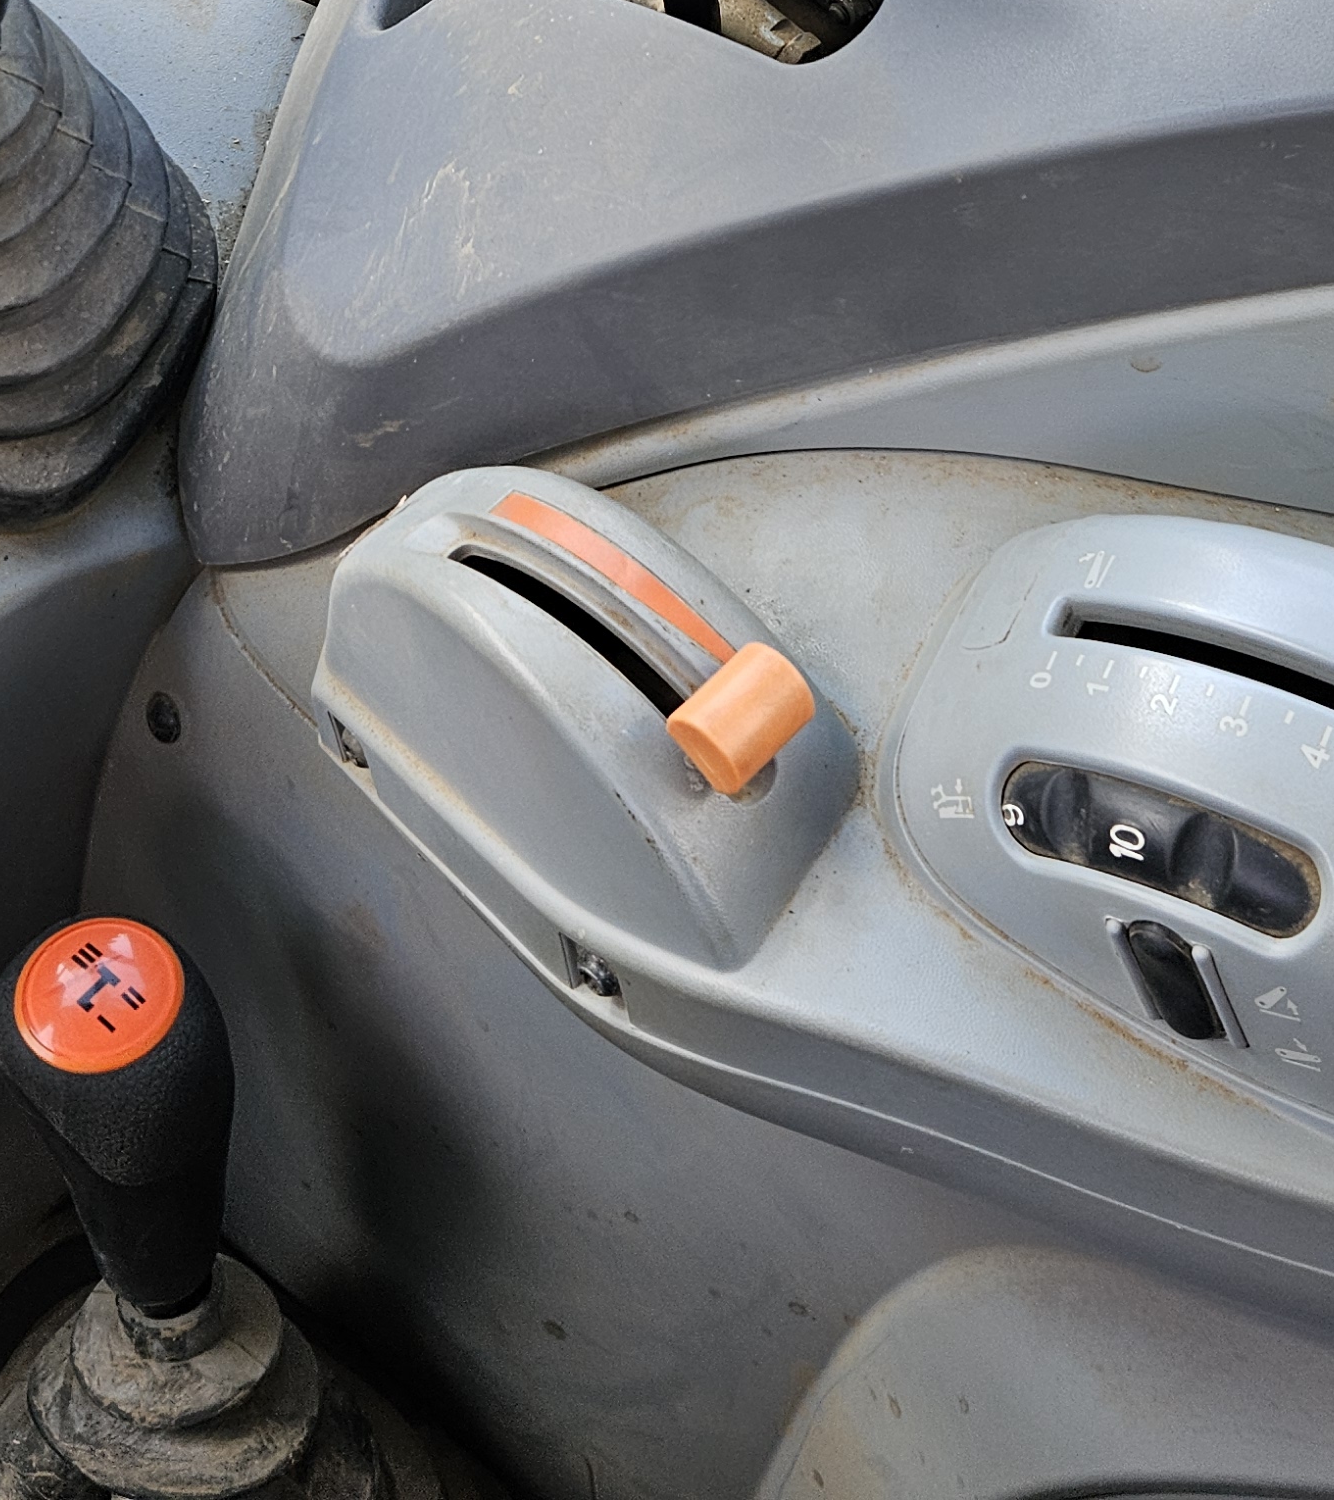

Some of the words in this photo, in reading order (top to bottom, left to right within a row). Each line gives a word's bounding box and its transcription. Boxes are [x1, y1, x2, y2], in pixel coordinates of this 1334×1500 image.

[1029, 671, 1052, 690] 0
[1085, 681, 1110, 696] 1
[1150, 693, 1180, 716] 2
[1219, 715, 1249, 738] 3
[1300, 742, 1331, 770] 4
[1108, 823, 1146, 862] 10
